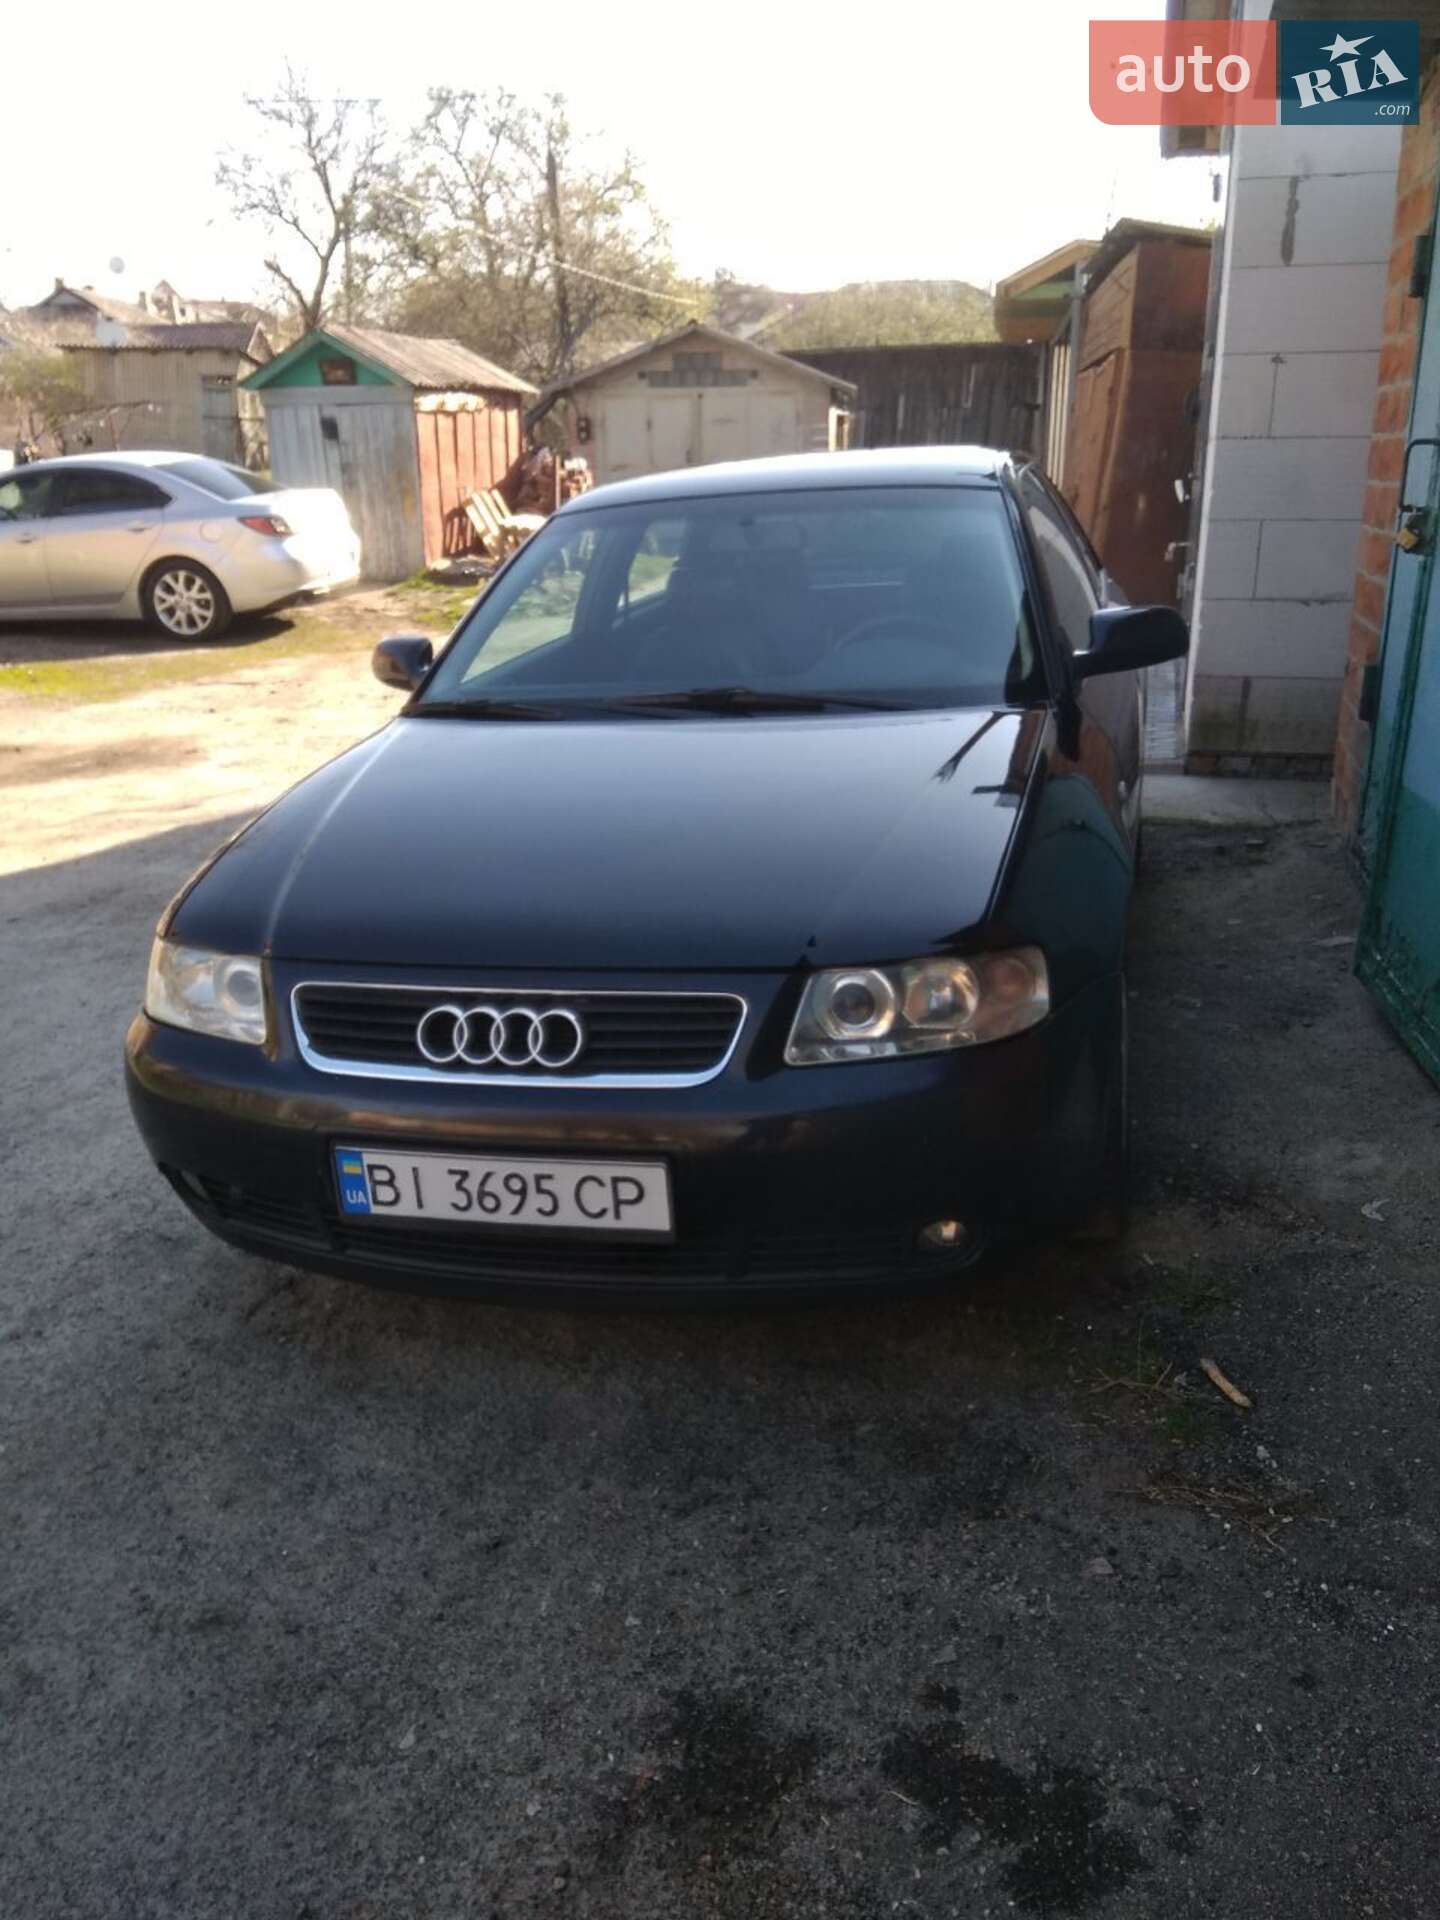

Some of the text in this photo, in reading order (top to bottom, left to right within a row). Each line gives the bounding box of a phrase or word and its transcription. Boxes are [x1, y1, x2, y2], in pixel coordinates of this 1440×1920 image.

[346, 1188, 367, 1204] UA
[367, 1163, 645, 1220] BI 3695 CP
